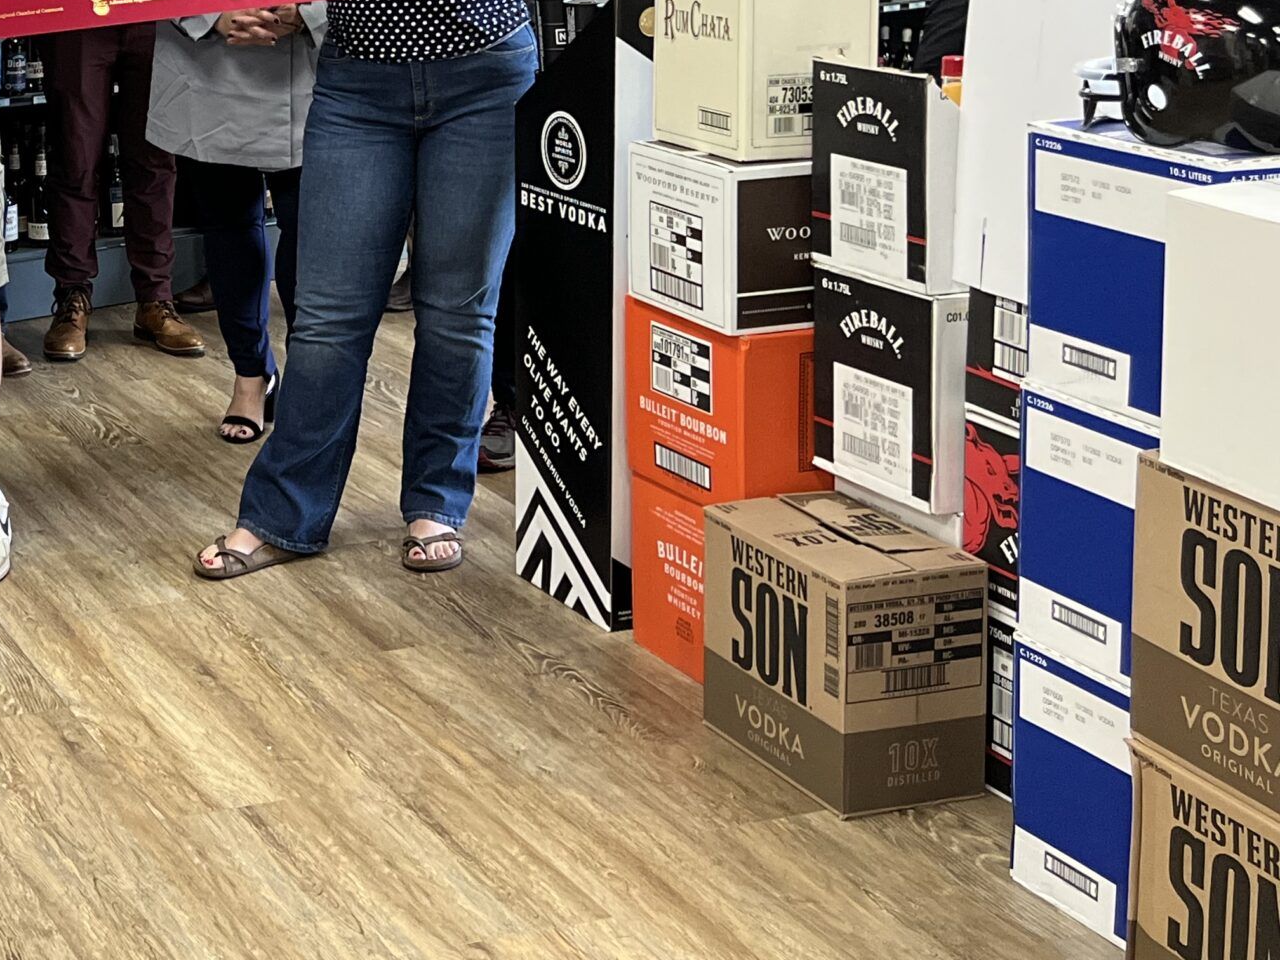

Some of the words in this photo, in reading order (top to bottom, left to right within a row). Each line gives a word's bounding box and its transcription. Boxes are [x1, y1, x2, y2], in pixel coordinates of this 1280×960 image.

[1141, 29, 1211, 79] FIREBALL
[1158, 50, 1183, 68] WHISKY
[820, 70, 825, 80] 6
[781, 86, 813, 103] 73053
[837, 96, 900, 140] FIREBALL
[857, 121, 880, 135] WHISKY
[1035, 138, 1062, 151] C.12226
[1169, 166, 1187, 178] 10.5
[1188, 171, 1213, 184] LITERS
[521, 189, 554, 214] BEST
[558, 202, 607, 233] VODKA
[822, 278, 827, 288] 6
[839, 309, 904, 358] FIREBALL
[861, 334, 884, 350] WHISKY
[526, 326, 546, 361] THE
[546, 358, 569, 396] WAY
[568, 391, 603, 451] EVERY
[1026, 395, 1054, 411] C.12226
[523, 353, 552, 401] OLIVE
[552, 398, 588, 463] WANTS
[530, 394, 545, 421] TO
[544, 422, 561, 454] GO.
[639, 395, 677, 423] BULLEIT
[680, 413, 727, 445] BOURBON
[521, 415, 540, 450] ULTRA
[539, 446, 566, 492] PREMIUM
[565, 489, 587, 529] VODKA
[657, 540, 704, 578] BULLEI
[730, 535, 808, 602] WESTERN
[664, 563, 704, 594] BOURBON
[667, 594, 702, 620] WHISKEY
[874, 611, 914, 628] 38508
[732, 566, 810, 707] SON
[989, 625, 1012, 645] 750ml
[1019, 646, 1048, 667] C.12226
[735, 693, 805, 760] VODKA
[1209, 685, 1269, 733] TEXAS
[747, 729, 792, 767] ORIGINAL
[888, 737, 939, 773] 10X
[1180, 695, 1280, 781] VODK
[887, 771, 940, 787] DISTILLED
[1200, 744, 1274, 794] ORIGINAL
